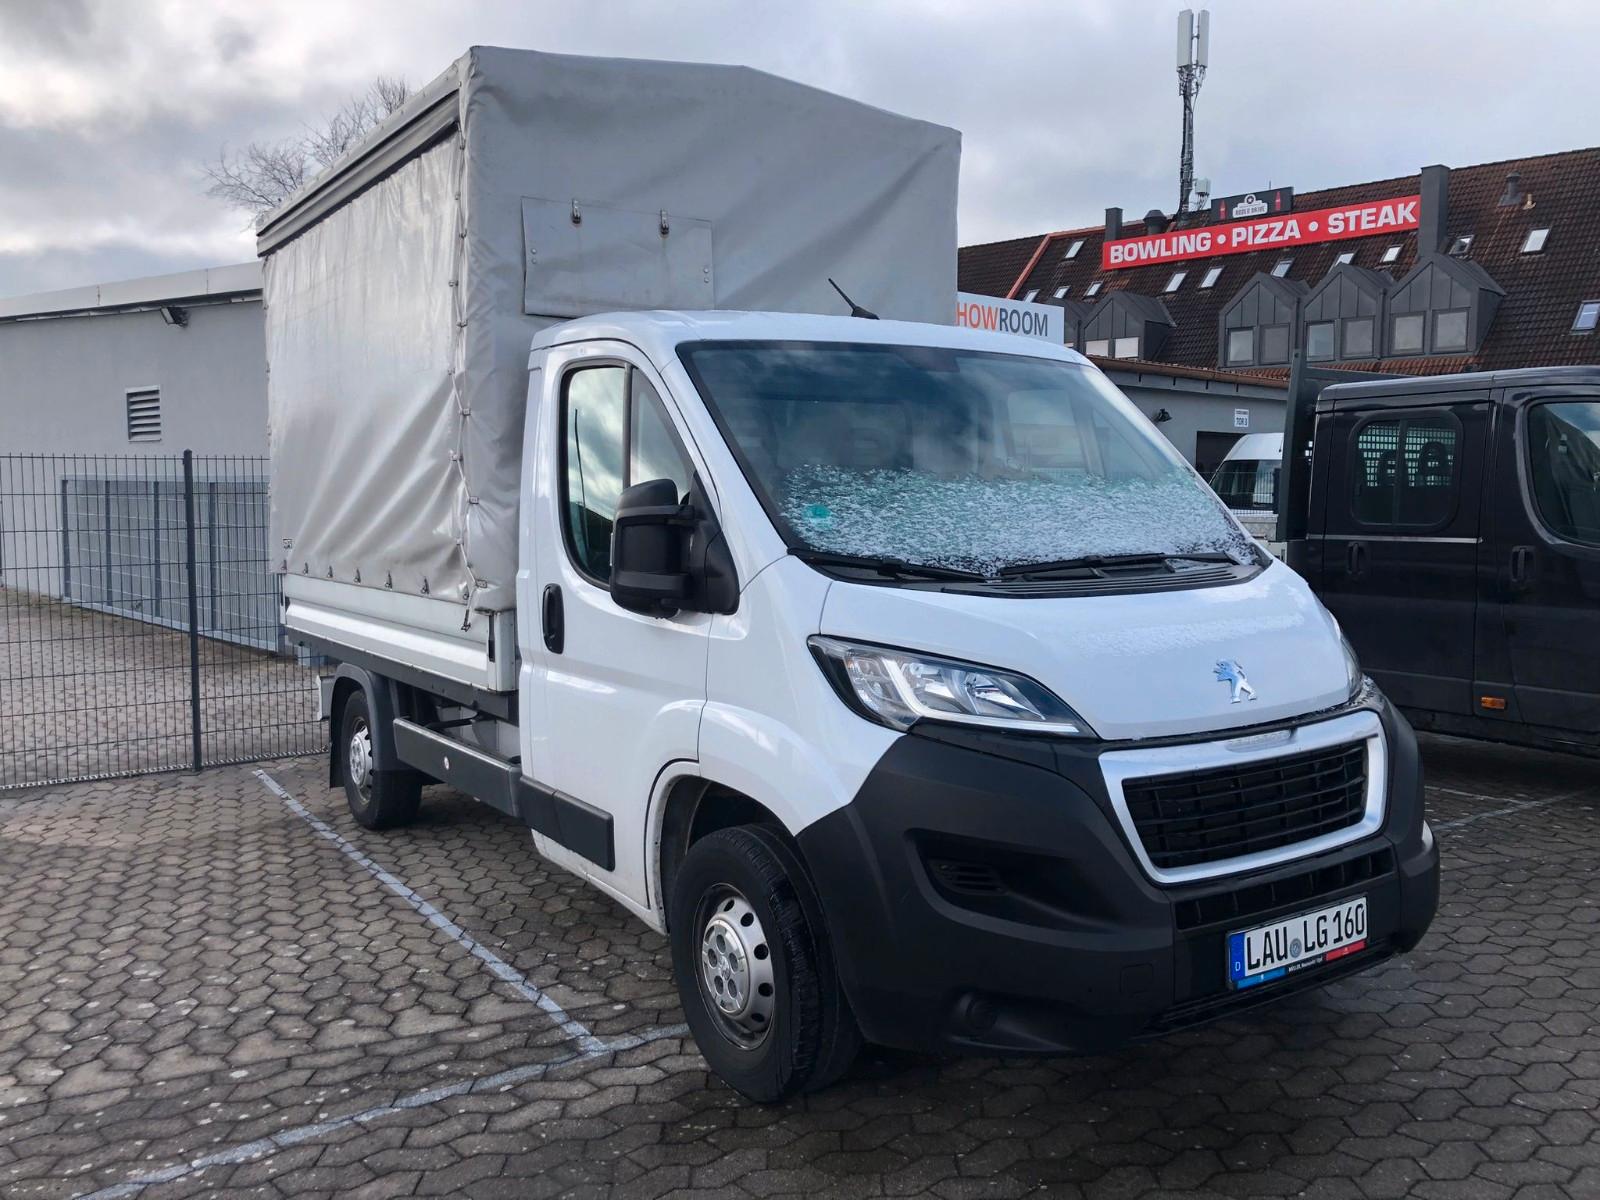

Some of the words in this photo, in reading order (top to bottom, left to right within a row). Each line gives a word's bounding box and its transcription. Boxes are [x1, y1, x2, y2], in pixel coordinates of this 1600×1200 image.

[1110, 232, 1212, 264] BOWLING
[1232, 219, 1301, 247] PIZZA
[1328, 201, 1417, 234] STEAK
[1235, 961, 1241, 971] D
[1246, 926, 1289, 970] LAU
[1303, 915, 1328, 953] LG
[1333, 903, 1365, 944] 160
